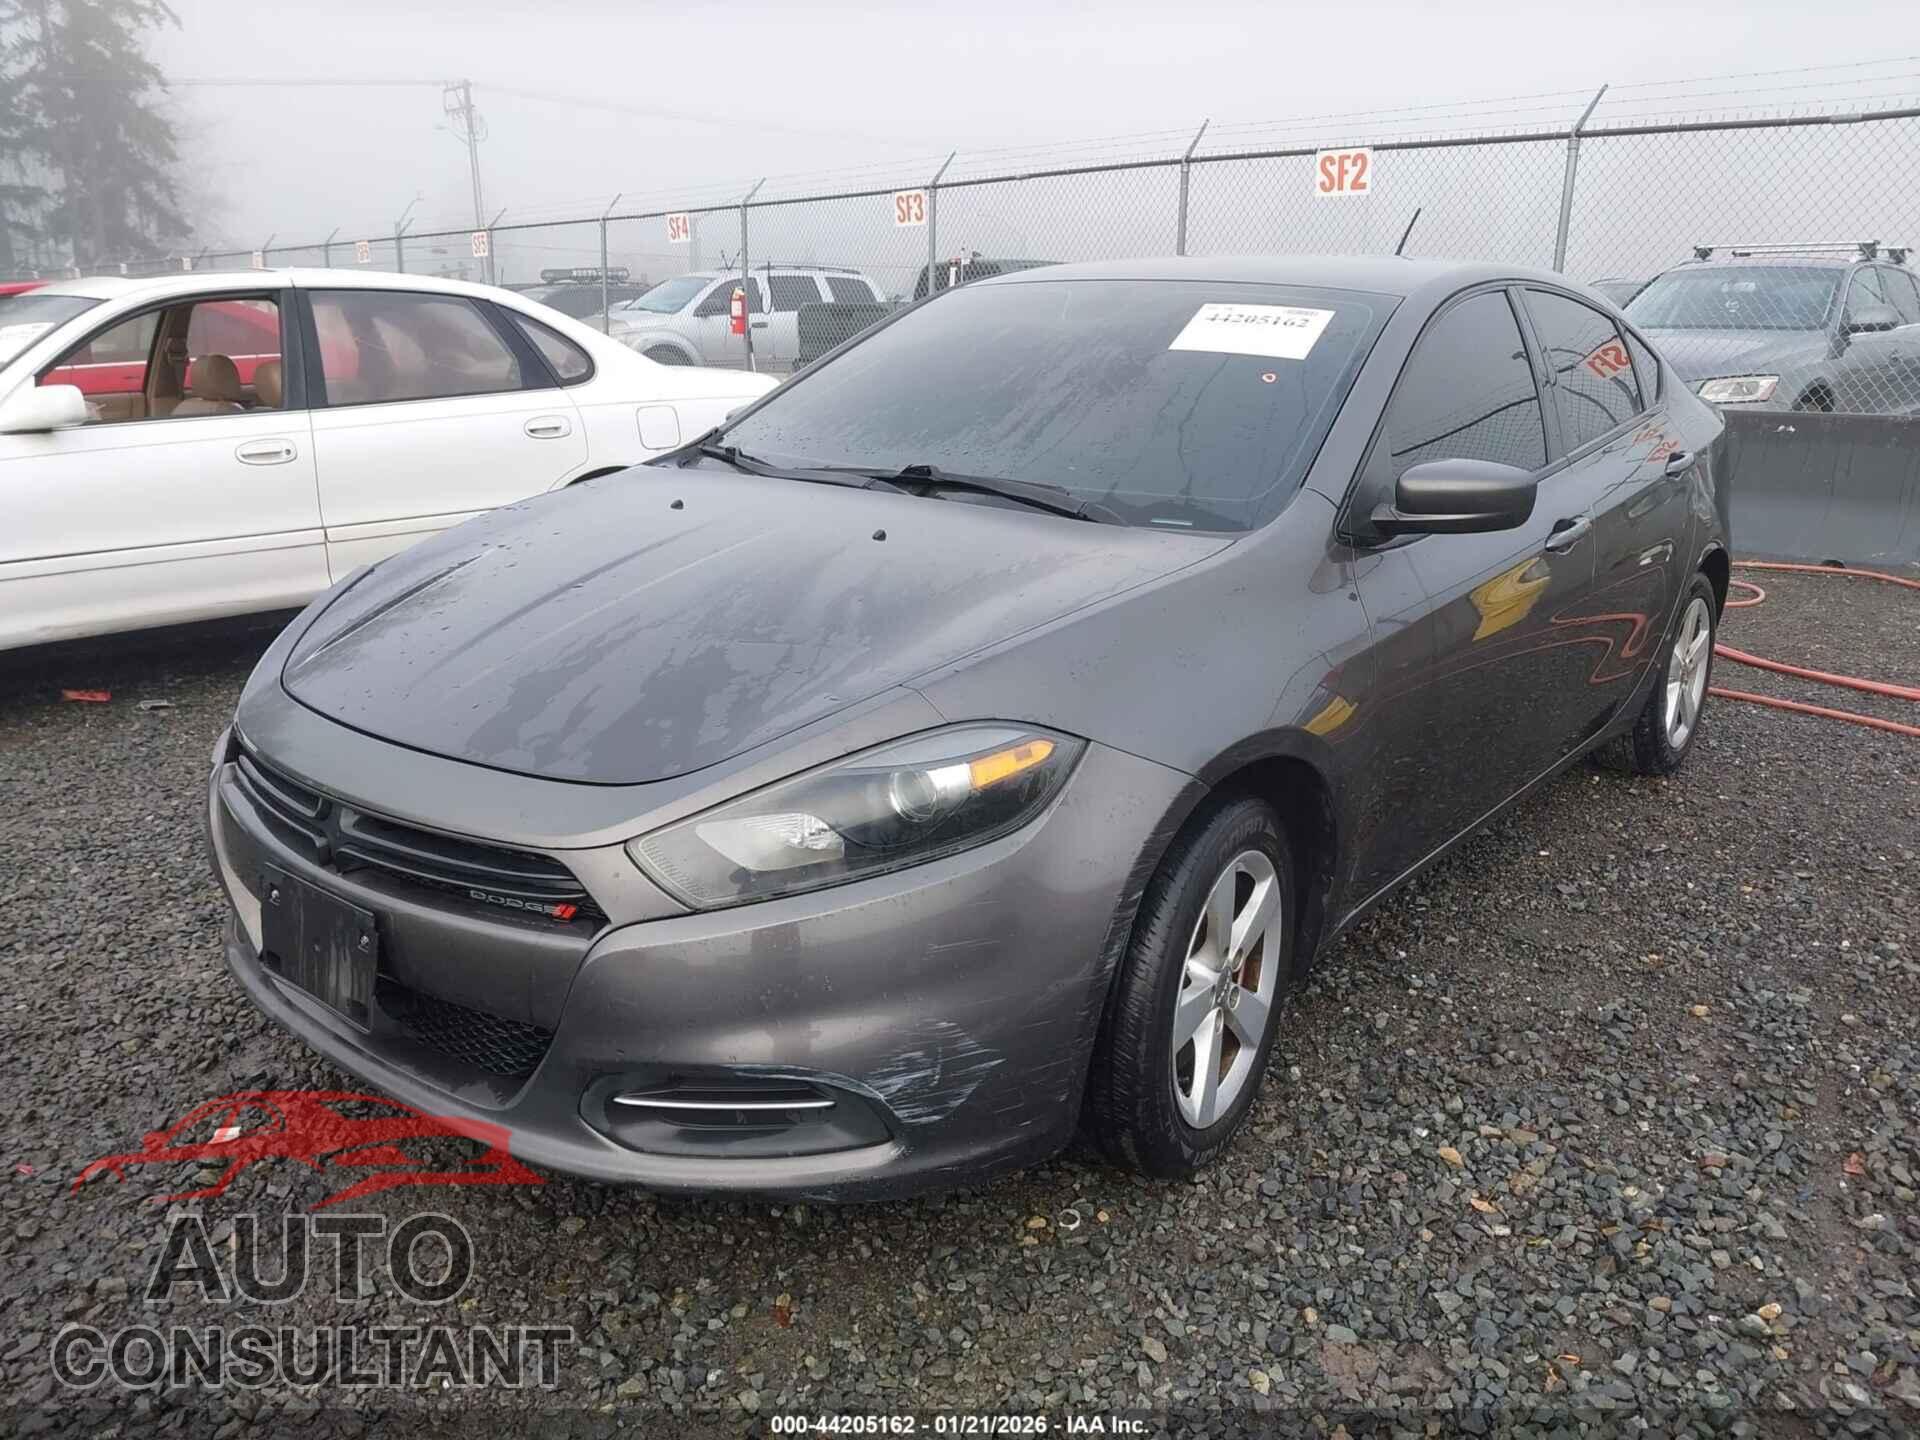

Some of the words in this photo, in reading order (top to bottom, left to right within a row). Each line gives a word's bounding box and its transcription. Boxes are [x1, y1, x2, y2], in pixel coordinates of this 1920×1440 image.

[1320, 153, 1367, 192] SF2
[896, 193, 923, 223] SF3
[669, 215, 688, 240] SF4
[1205, 313, 1310, 328] 44205162
